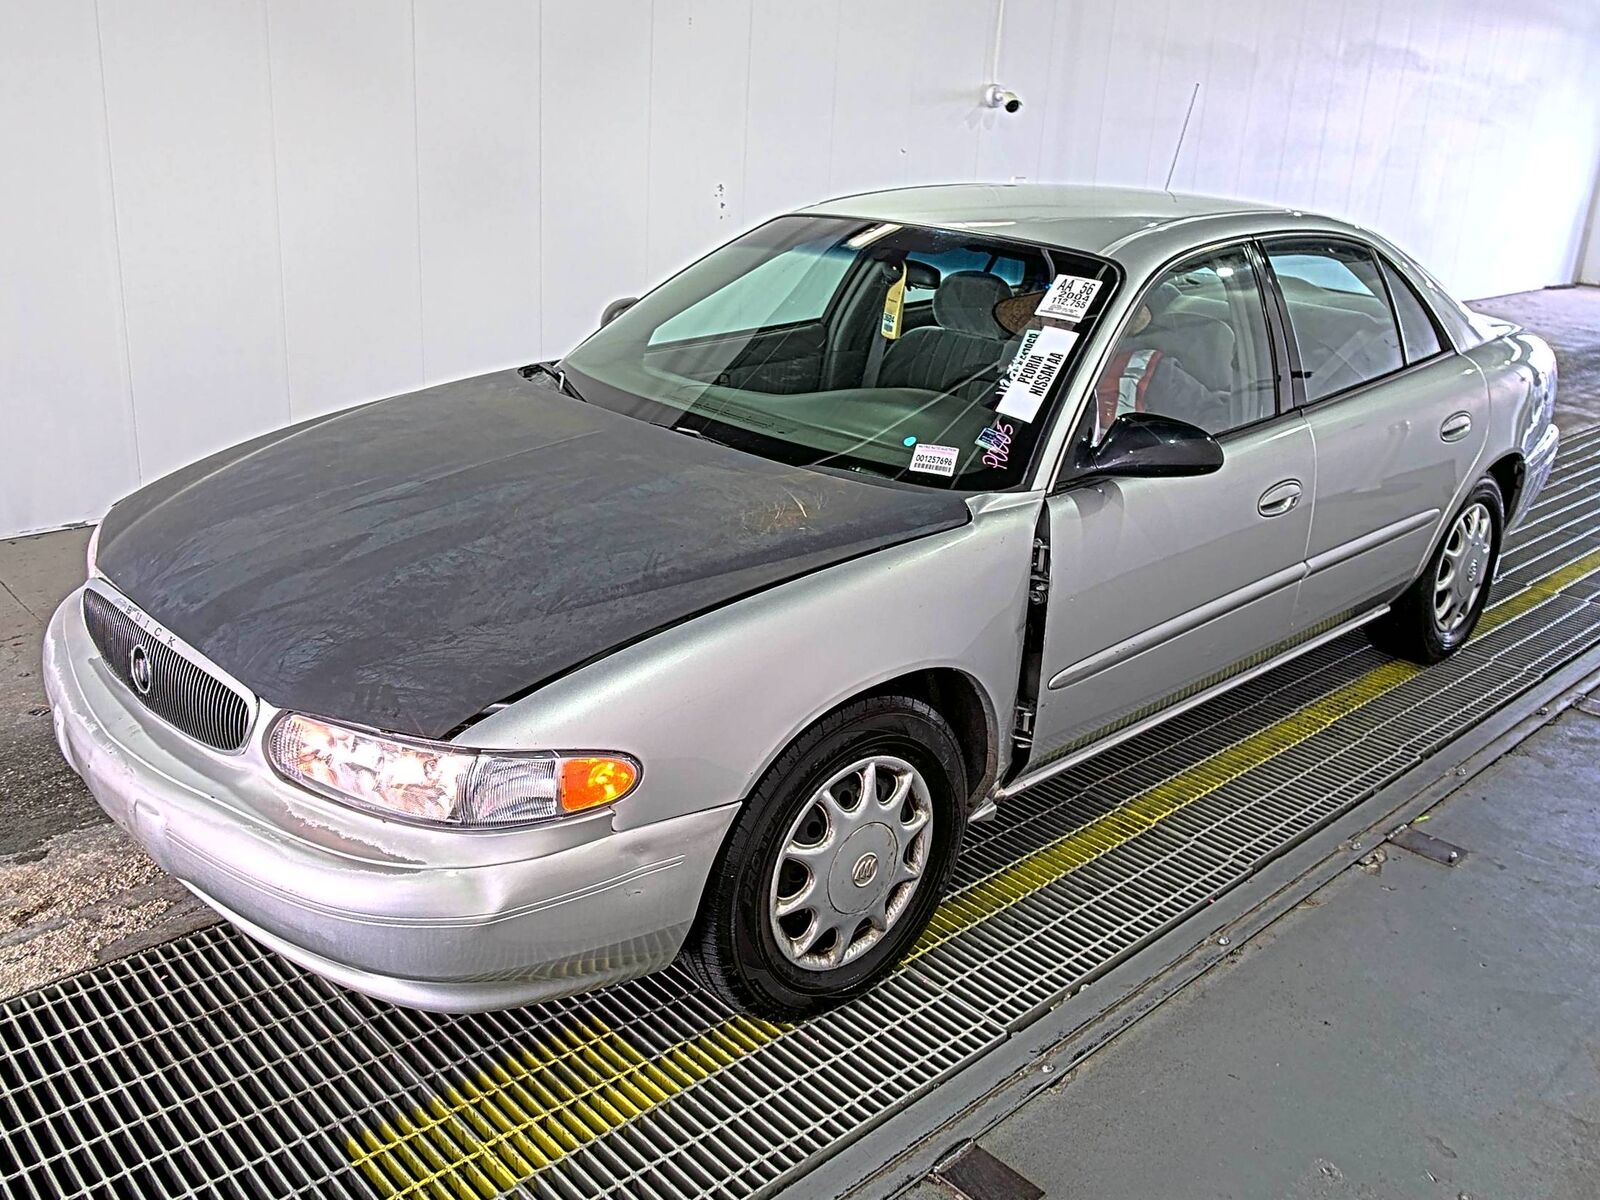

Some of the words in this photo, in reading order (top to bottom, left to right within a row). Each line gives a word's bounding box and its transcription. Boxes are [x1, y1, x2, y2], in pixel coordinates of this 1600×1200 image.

[1057, 279, 1075, 291] AA
[1080, 282, 1096, 295] 56
[1058, 290, 1090, 302] 2004
[1017, 355, 1044, 384] PEORIA
[1029, 364, 1057, 396] NISSAN
[1047, 353, 1064, 366] AA
[915, 454, 953, 466] 001257696
[125, 605, 176, 648] BUICK
